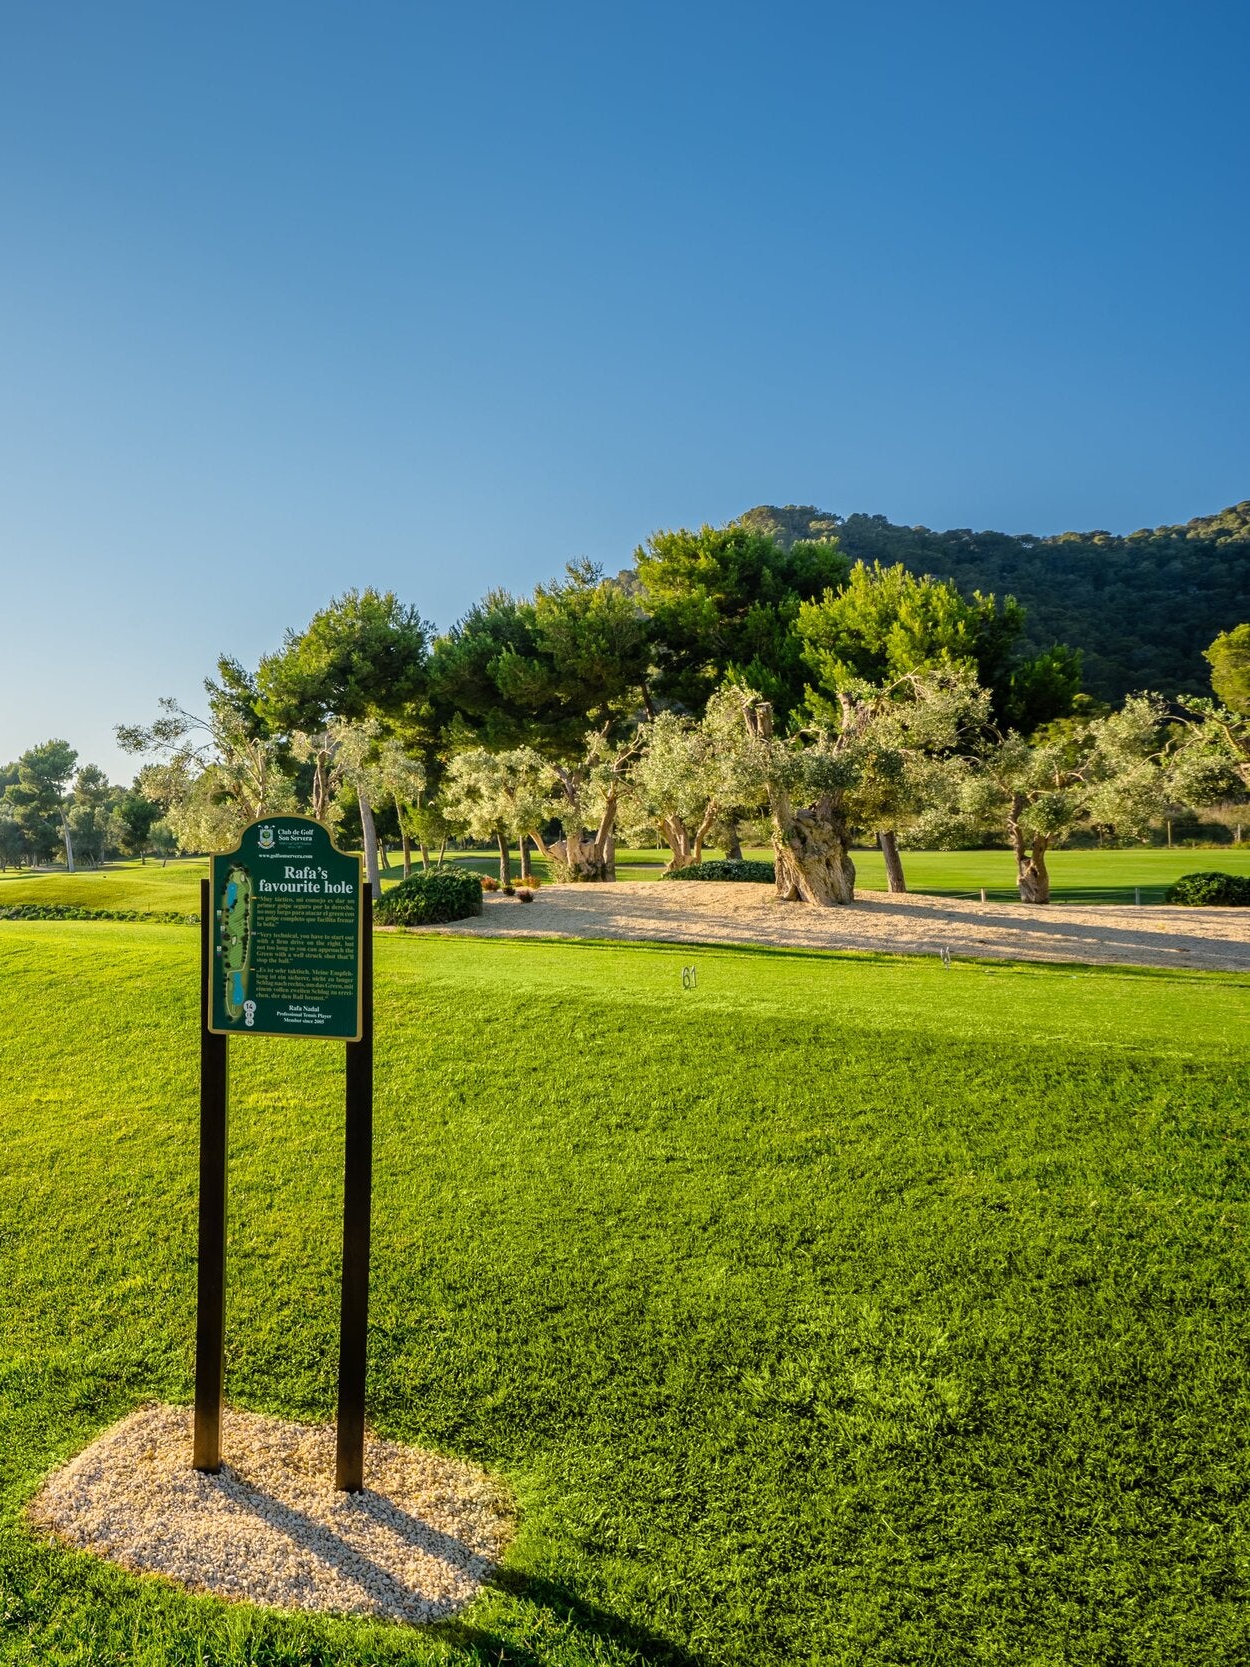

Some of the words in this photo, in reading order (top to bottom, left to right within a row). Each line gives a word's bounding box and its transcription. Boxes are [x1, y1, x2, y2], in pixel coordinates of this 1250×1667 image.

[259, 880, 320, 893] favourite
[324, 882, 353, 894] hole
[683, 966, 696, 990] 61
